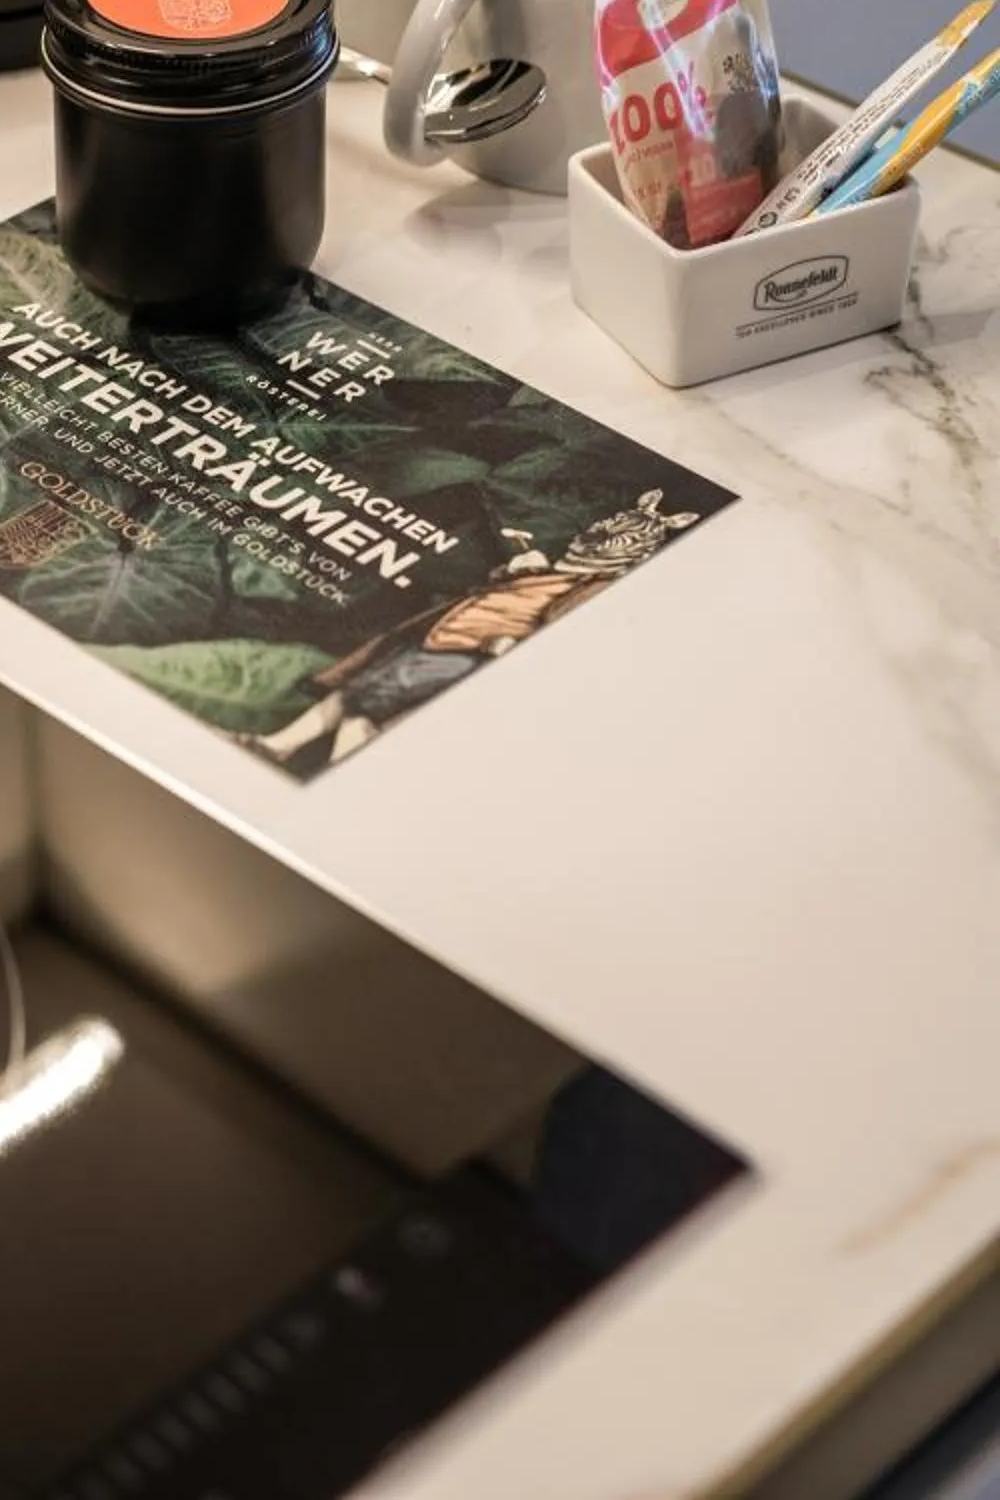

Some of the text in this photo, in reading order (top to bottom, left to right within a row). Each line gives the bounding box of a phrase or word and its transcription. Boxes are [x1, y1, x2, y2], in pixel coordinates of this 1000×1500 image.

[276, 351, 367, 402] NER
[306, 331, 395, 385] WER
[0, 371, 99, 432] VIELLEICHT
[97, 431, 169, 475] BESTEN
[168, 473, 244, 518] KAFFEE
[308, 552, 353, 581] VON
[12, 302, 460, 554] AUCH NACH DEM AUFWACHEN
[54, 428, 95, 453] UND
[93, 455, 153, 488] JETZT
[152, 487, 207, 519] AUCH
[207, 517, 234, 536] IM
